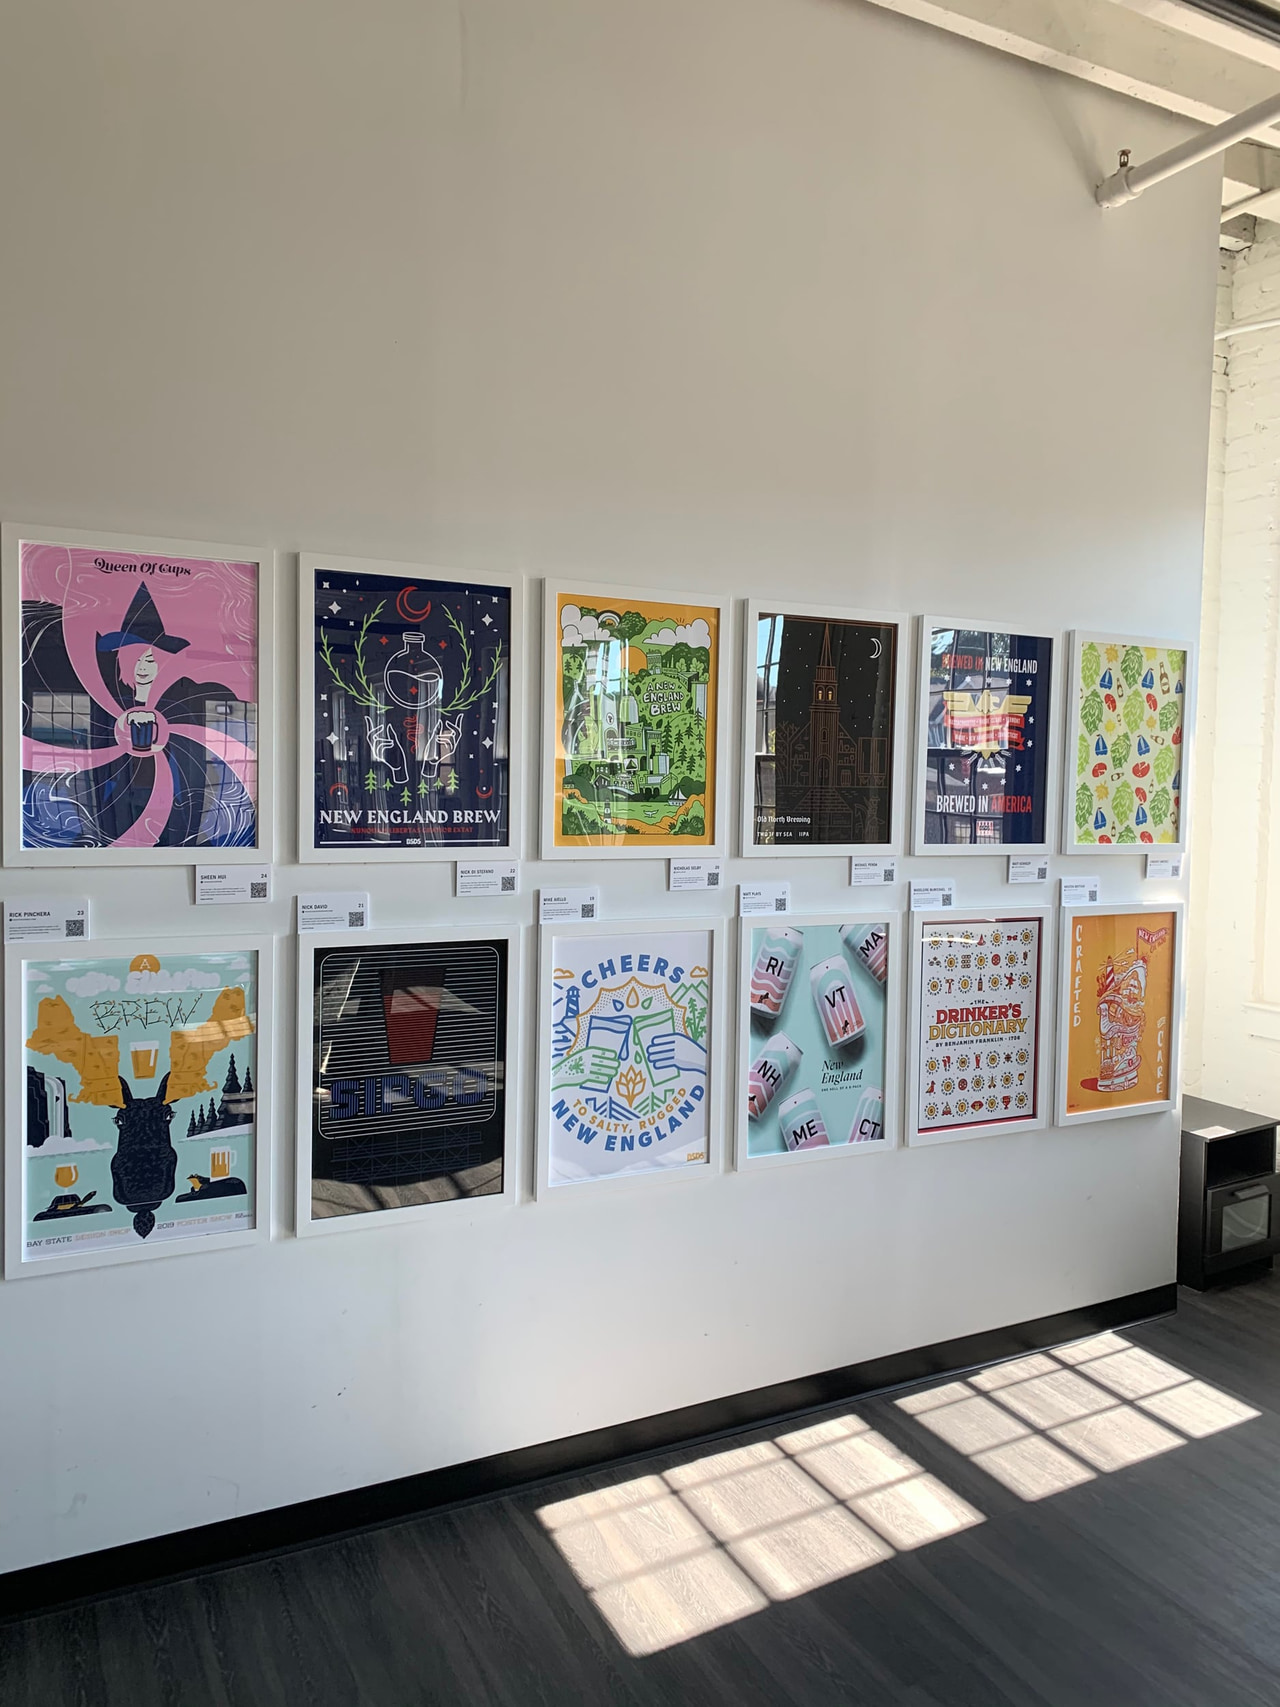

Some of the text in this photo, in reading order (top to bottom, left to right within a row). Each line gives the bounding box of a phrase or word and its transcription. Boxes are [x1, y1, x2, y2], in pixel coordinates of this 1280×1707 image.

[94, 557, 192, 577] Queen Of Cups
[941, 653, 1038, 674] BREWED IN NEW ENGLAND
[647, 681, 676, 691] A NEW
[643, 691, 685, 703] ENGLAND
[650, 702, 682, 716] BREW
[936, 794, 1032, 813] BREWED IN AMERICA
[319, 809, 501, 824] NEW ENGLAND BREW
[757, 815, 811, 824] Old North Brewing
[859, 931, 883, 958] MA
[139, 958, 151, 969] A
[581, 954, 685, 989] CHEERS
[765, 956, 785, 977] RI
[1073, 924, 1083, 1027] CRAFTED
[825, 986, 845, 1009] VT
[89, 993, 203, 1034] BREW
[936, 1003, 1022, 1025] DRINKER'S
[928, 1018, 1028, 1041] DICTIONARY
[821, 1060, 844, 1072] New
[1156, 1030, 1164, 1094] CARE
[757, 1060, 782, 1087] NH
[821, 1069, 863, 1086] England
[551, 1084, 705, 1152] NEW ENGLAND
[572, 1087, 687, 1134] TO SALTY, RUGGED
[792, 1119, 818, 1146] ME
[859, 1118, 881, 1139] CT
[26, 1239, 43, 1248] BAY
[44, 1235, 73, 1246] STATE
[157, 1221, 175, 1230] 2019
